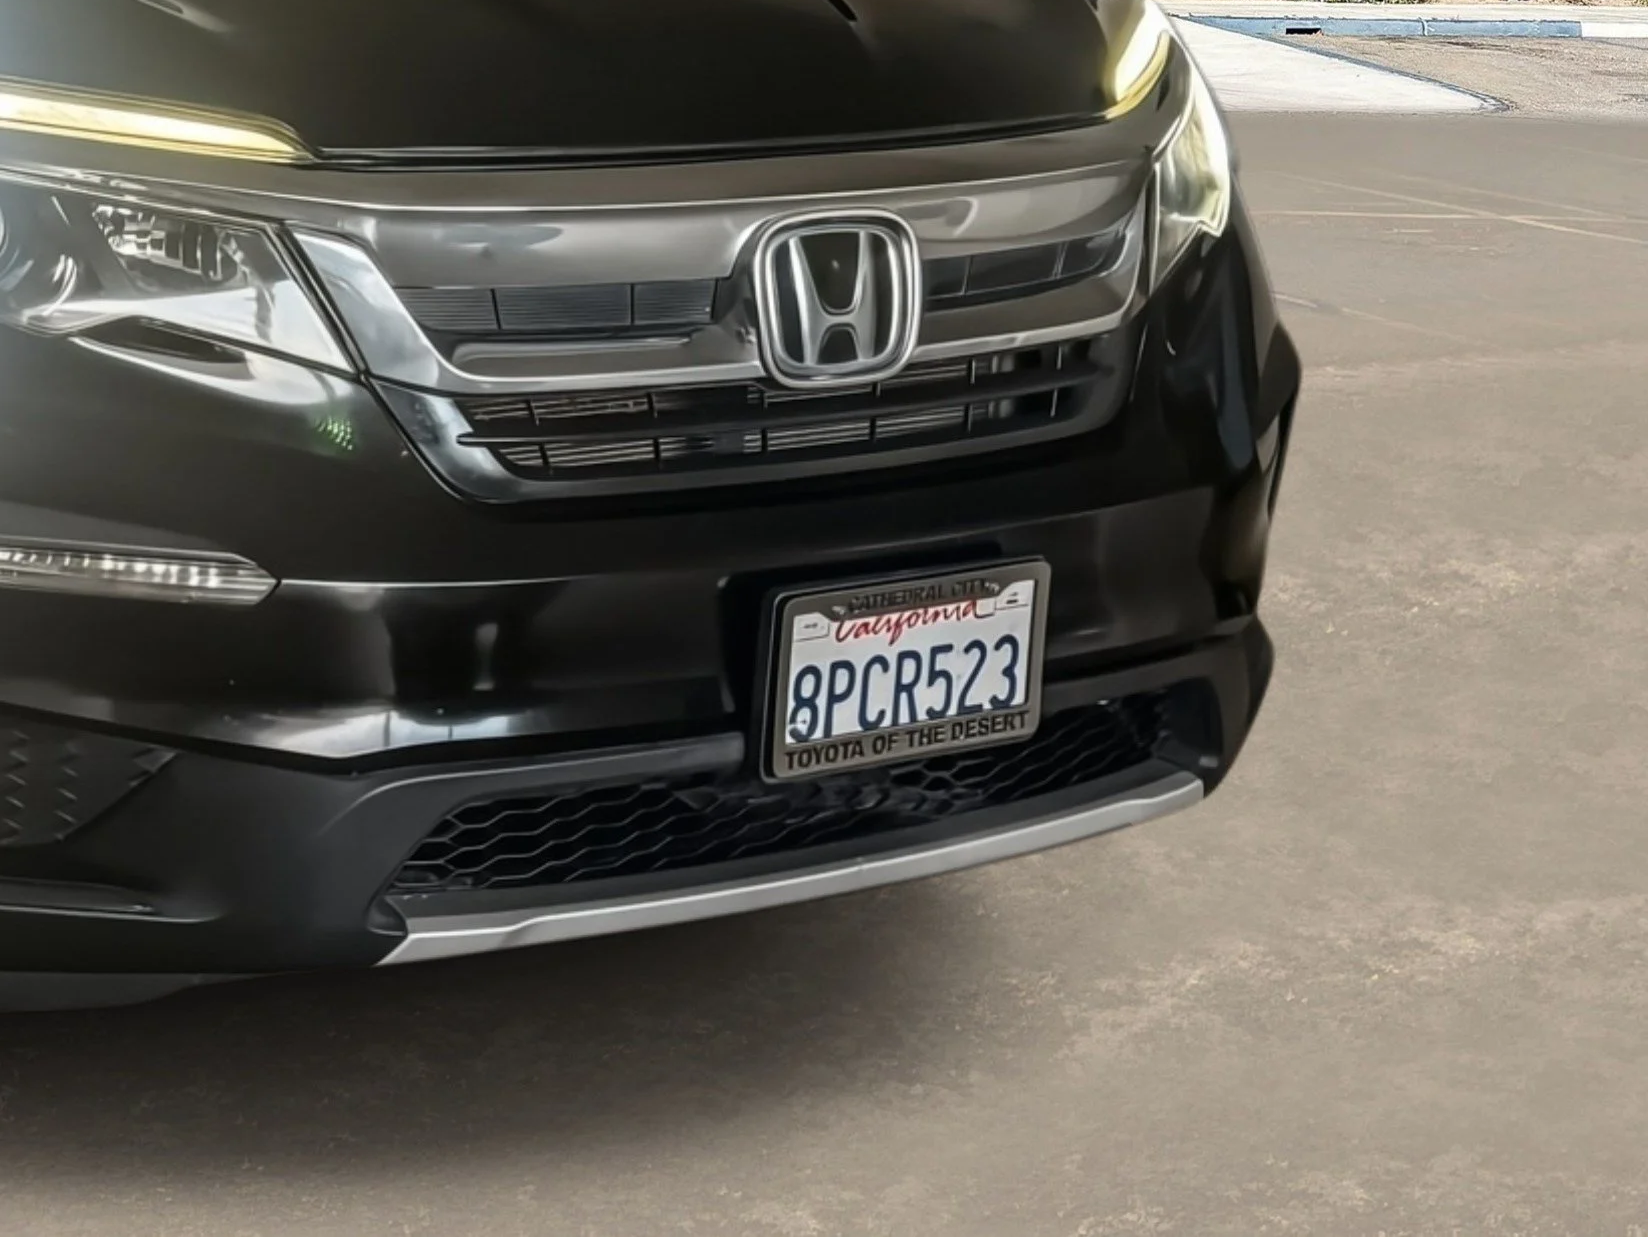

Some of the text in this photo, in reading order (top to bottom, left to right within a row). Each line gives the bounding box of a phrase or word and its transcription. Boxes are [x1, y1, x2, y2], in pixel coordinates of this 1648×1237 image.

[835, 600, 978, 645] California
[788, 634, 1020, 743] 8PCR523
[784, 712, 1030, 770] TOYOTA OF THE DESERT
